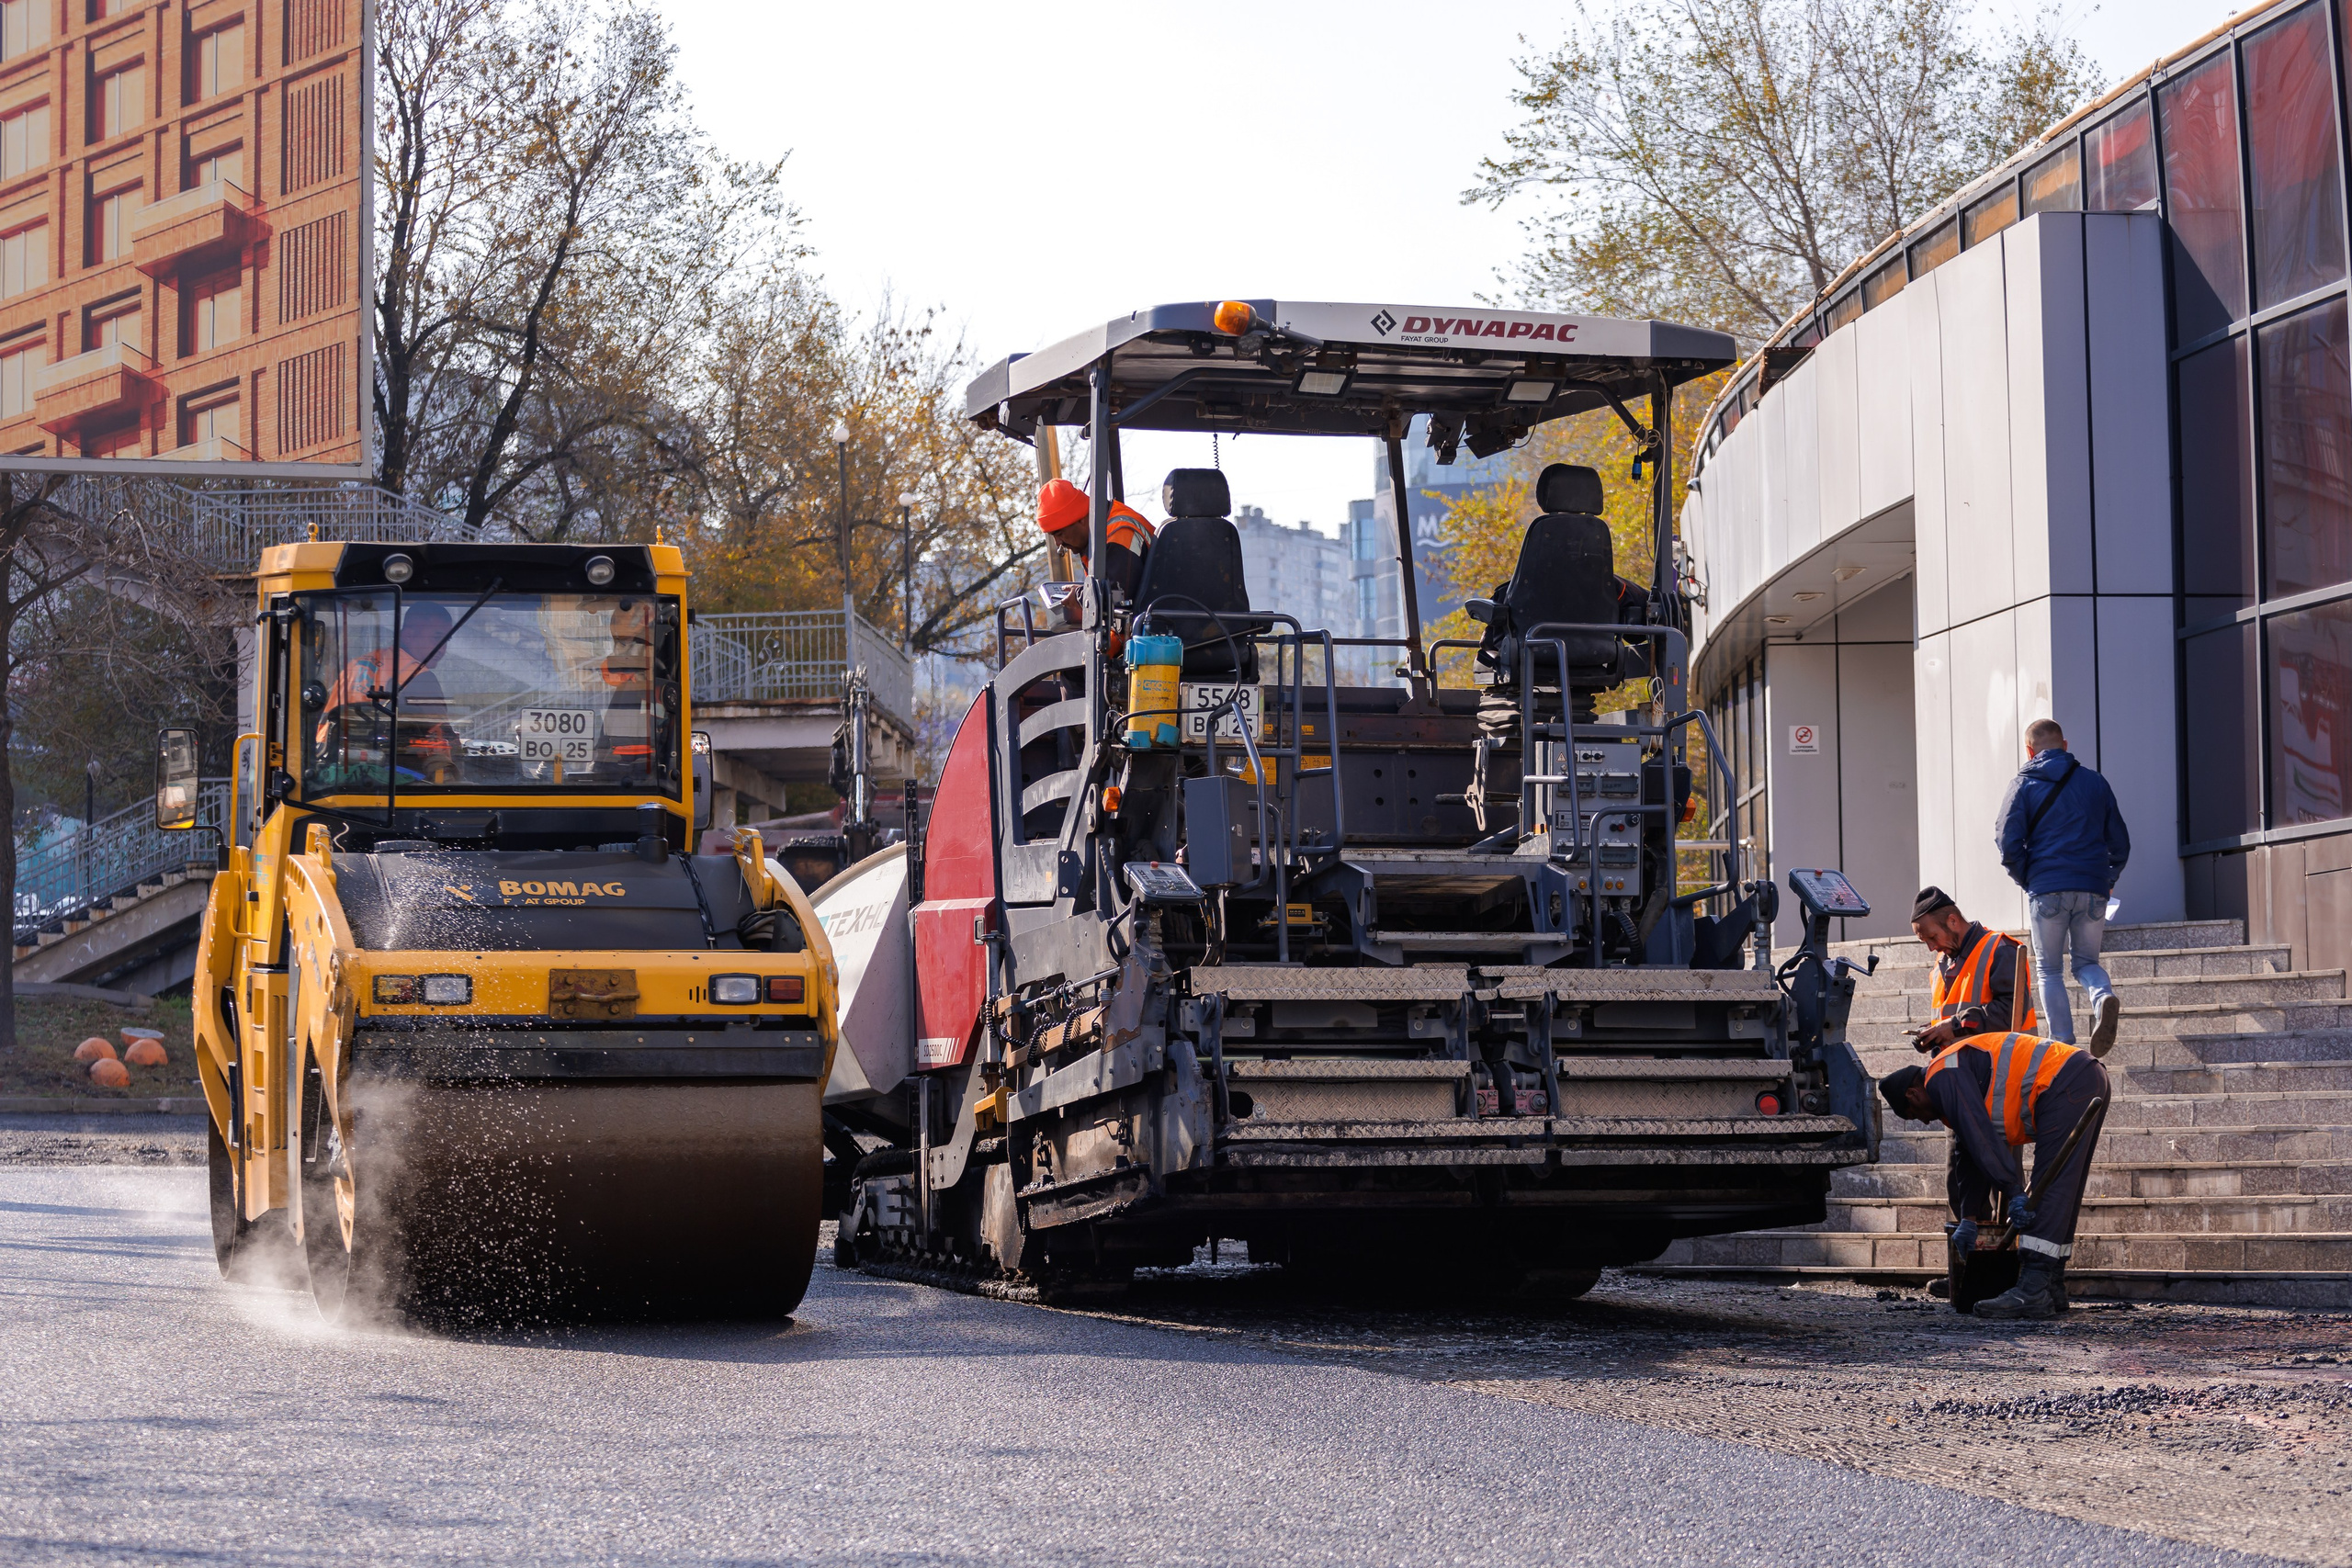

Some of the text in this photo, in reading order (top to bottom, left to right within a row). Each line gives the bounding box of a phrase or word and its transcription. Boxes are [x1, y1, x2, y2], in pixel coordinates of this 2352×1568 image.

[1401, 316, 1579, 343] DYNAPAC
[529, 712, 586, 734] 3080
[566, 741, 587, 758] 25
[498, 880, 627, 897] BOMAG
